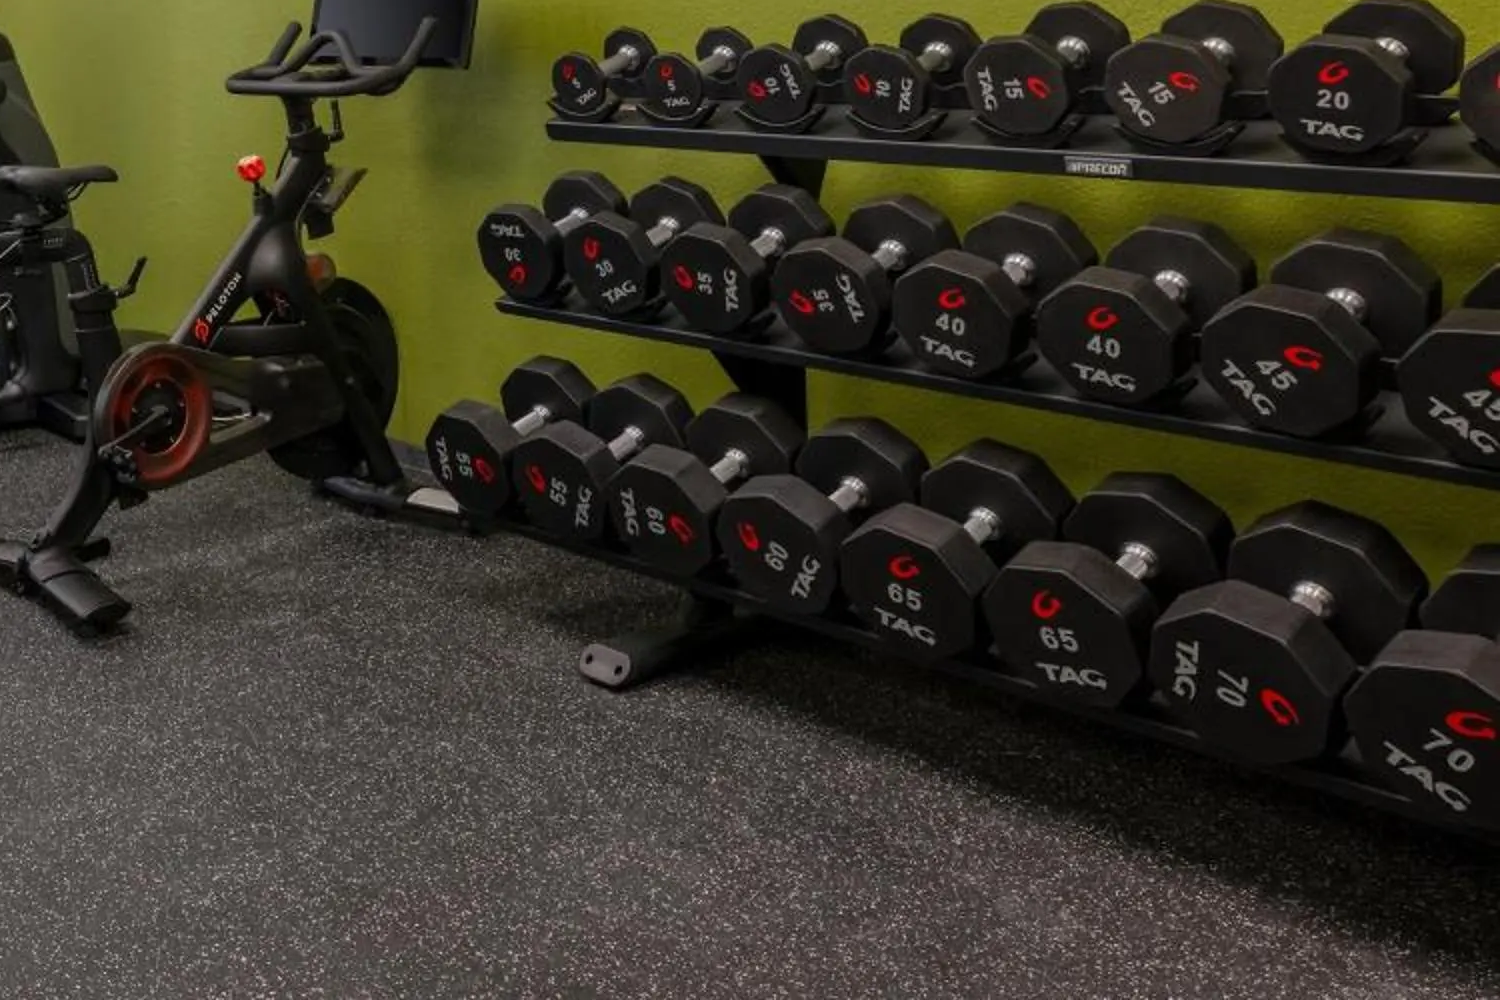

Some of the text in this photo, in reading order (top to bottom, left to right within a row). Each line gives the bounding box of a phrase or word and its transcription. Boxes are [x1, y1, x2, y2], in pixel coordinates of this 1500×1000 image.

[779, 63, 801, 100] TAG
[898, 78, 913, 113] TAG
[977, 66, 998, 112] TAG
[1003, 78, 1025, 100] 15
[1148, 81, 1176, 105] 15
[662, 96, 691, 107] TAG
[1117, 81, 1156, 127] TAG
[1316, 88, 1350, 110] 20
[1300, 118, 1364, 141] TAG
[595, 259, 614, 278] 30
[697, 271, 713, 295] 35
[206, 272, 242, 324] PELOTON
[601, 279, 637, 303] TAG
[723, 267, 739, 312] TAG
[813, 288, 835, 312] 35
[835, 273, 865, 323] TAG
[935, 313, 965, 336] 40
[919, 335, 975, 367] TAG
[1086, 334, 1121, 359] 40
[1071, 362, 1136, 392] TAG
[1221, 359, 1277, 416] TAG
[1255, 361, 1298, 391] 45
[1427, 395, 1500, 454] TAG
[435, 436, 453, 480] TAG
[549, 477, 567, 506] 55
[574, 486, 593, 528] TAG
[619, 488, 640, 537] TAG
[645, 506, 667, 535] 60
[764, 540, 789, 572] 60
[790, 555, 822, 599] TAG
[886, 583, 923, 611] 65
[873, 606, 937, 646] TAG
[1039, 626, 1079, 653] 65
[1035, 662, 1108, 690] TAG
[1172, 640, 1200, 701] TAG
[1216, 669, 1249, 708] 70
[1423, 727, 1475, 773] 70
[1383, 740, 1472, 812] TAG
